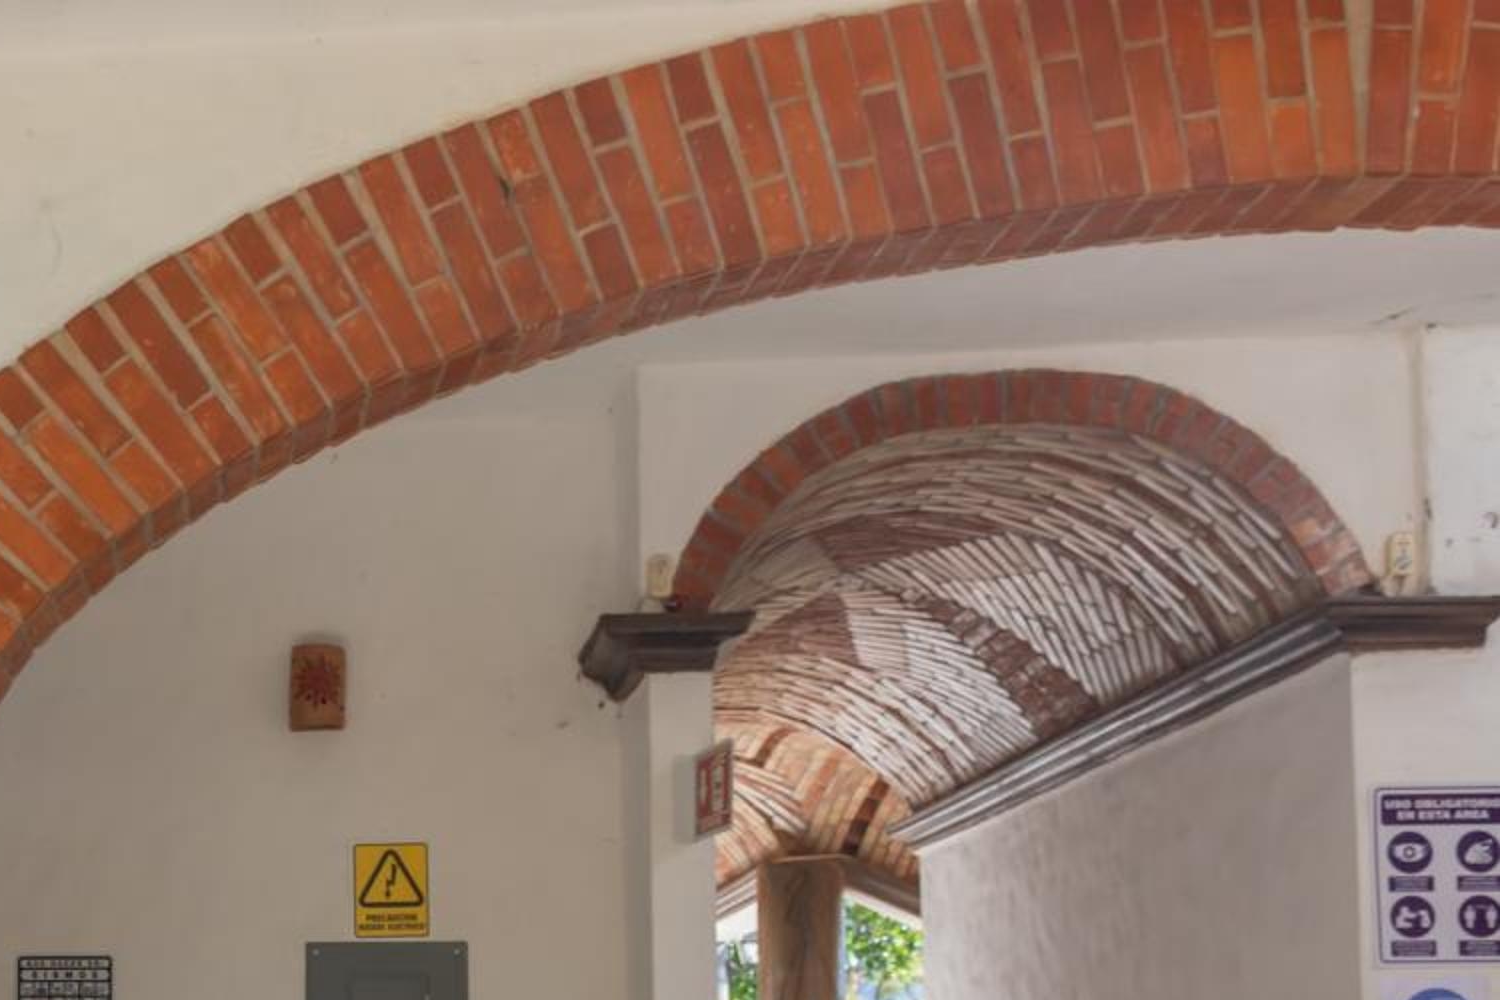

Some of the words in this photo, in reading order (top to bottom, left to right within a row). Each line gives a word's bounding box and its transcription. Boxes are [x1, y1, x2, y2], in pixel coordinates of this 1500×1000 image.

[1384, 799, 1412, 810] USO
[1396, 810, 1415, 821] EN
[1418, 810, 1451, 820] ESTA
